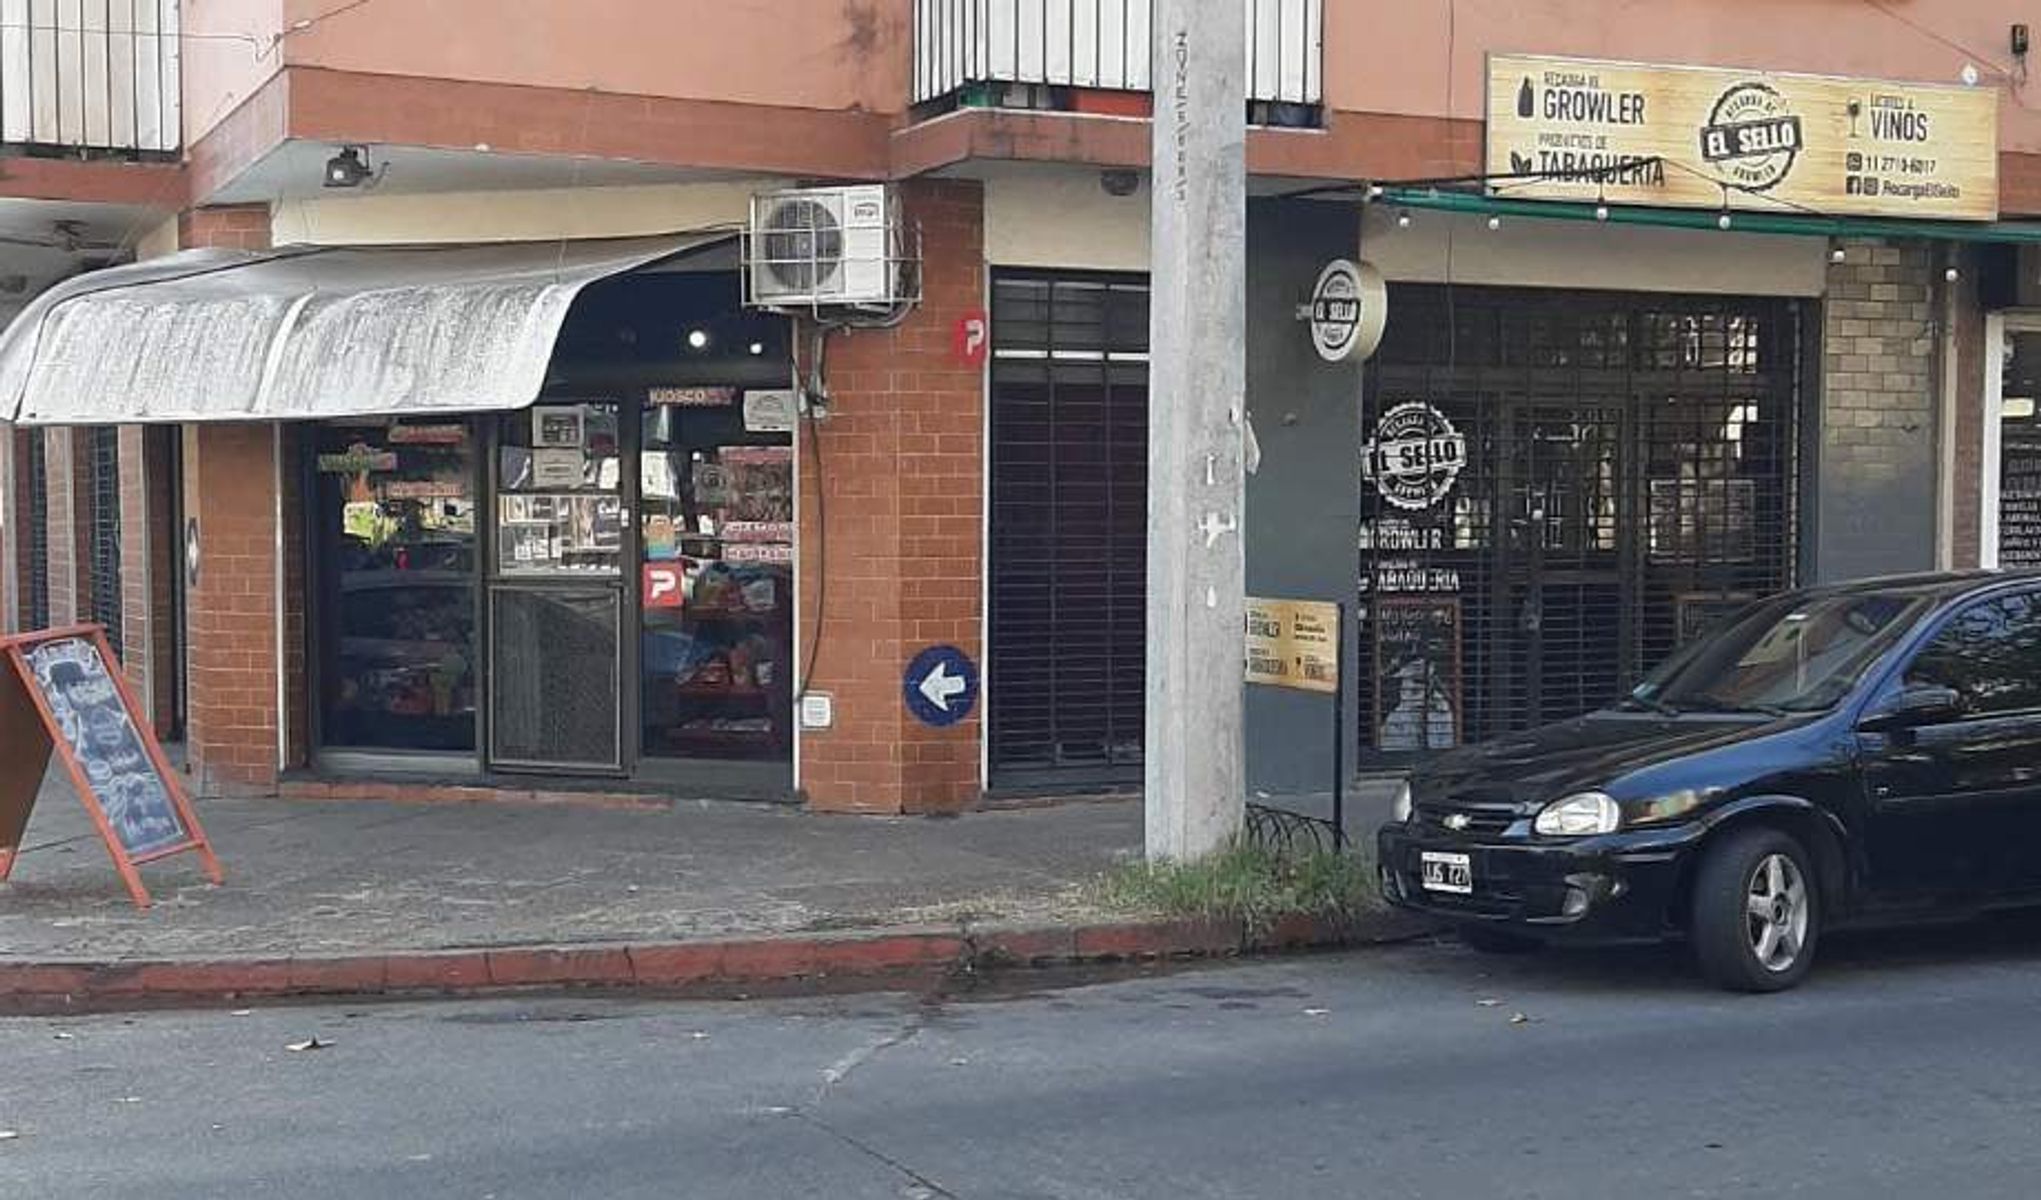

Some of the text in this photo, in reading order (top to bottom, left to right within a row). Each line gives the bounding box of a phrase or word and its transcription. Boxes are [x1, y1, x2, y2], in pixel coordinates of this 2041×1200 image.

[1543, 88, 1645, 125] GROWLER
[1707, 122, 1795, 157] EL SELLO
[1870, 110, 1928, 142] VINOS
